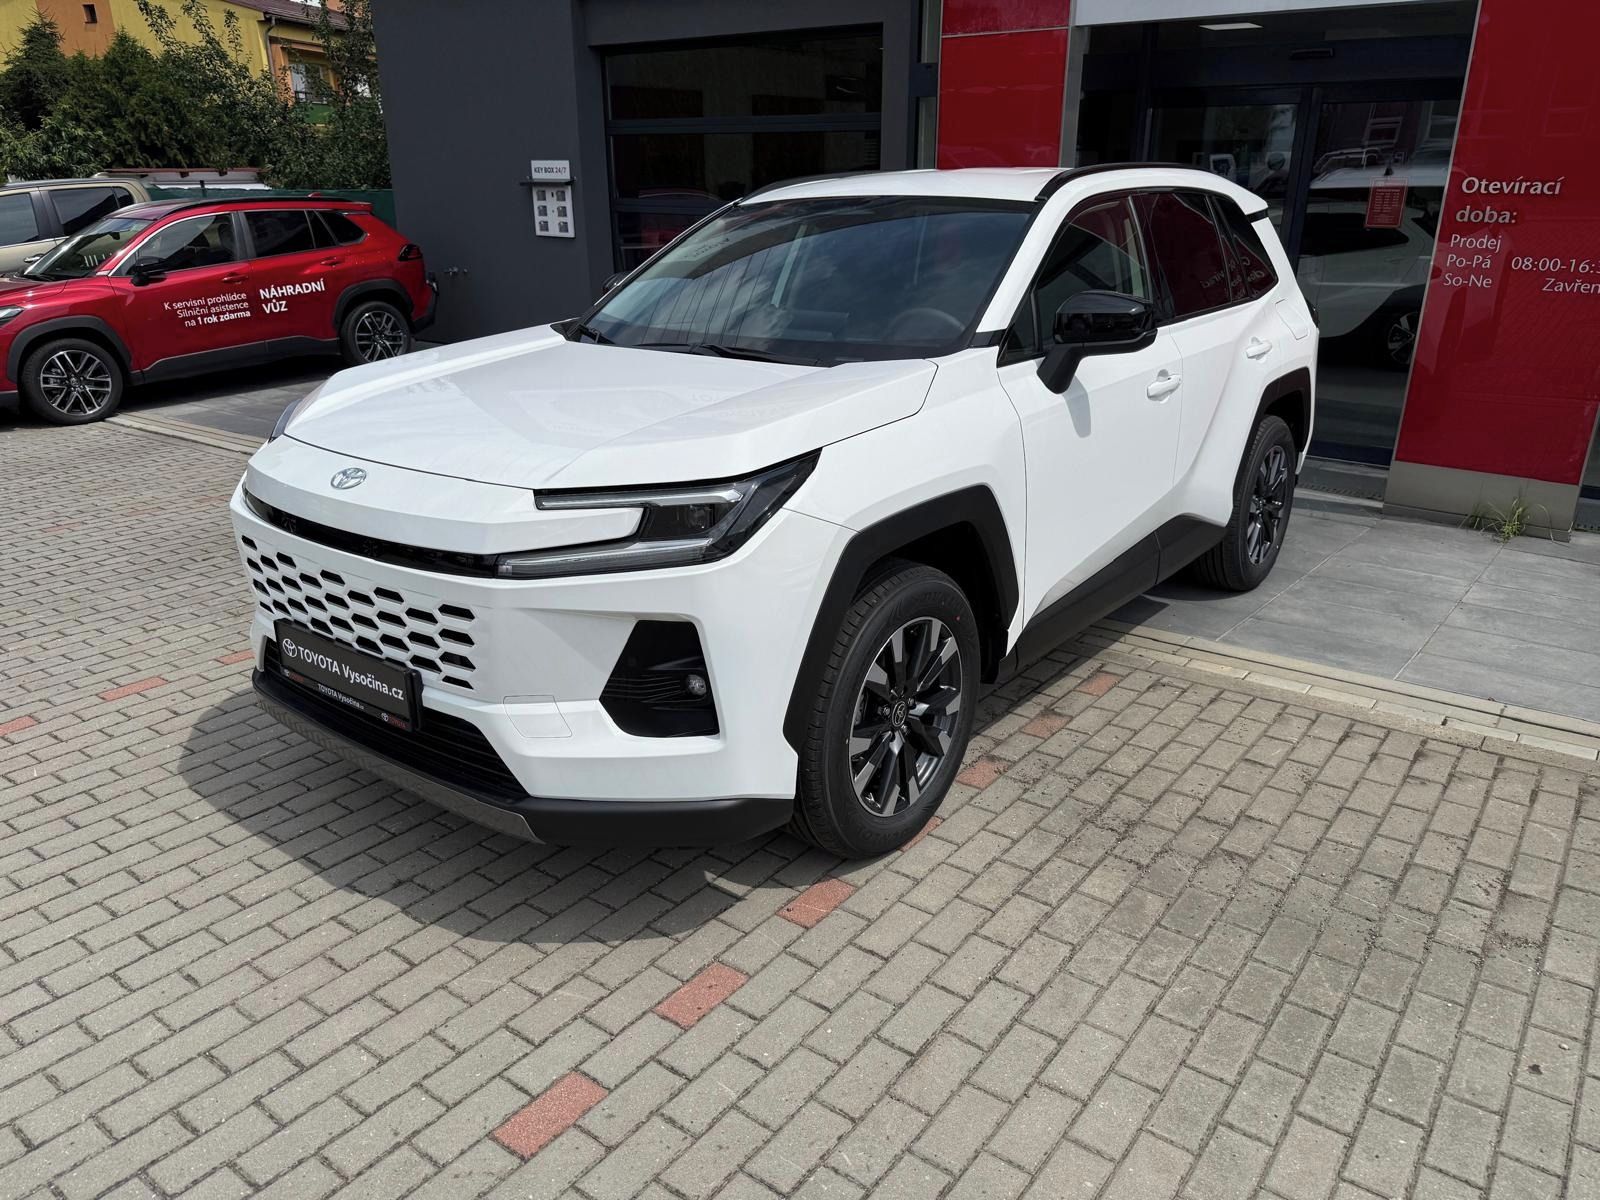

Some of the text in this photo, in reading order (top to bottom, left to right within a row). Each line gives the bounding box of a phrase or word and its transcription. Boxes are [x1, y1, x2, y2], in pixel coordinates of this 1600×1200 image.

[555, 167, 567, 175] 24/7
[1461, 176, 1565, 195] Otevírací
[1455, 206, 1518, 224] doba:
[1450, 234, 1502, 253] Prodej
[1446, 254, 1492, 269] Po-Pá
[259, 278, 326, 300] NÁHRADNÍ
[1443, 273, 1493, 288] So-Ne
[1542, 277, 1600, 294] Zavřen
[164, 292, 247, 310] K servisní prohlídce
[262, 299, 288, 314] VŮZ
[177, 302, 249, 318] Silniční asistence
[184, 311, 251, 327] na 1 rok zdarma
[298, 646, 404, 701] TOYOTA Vysočina.cz
